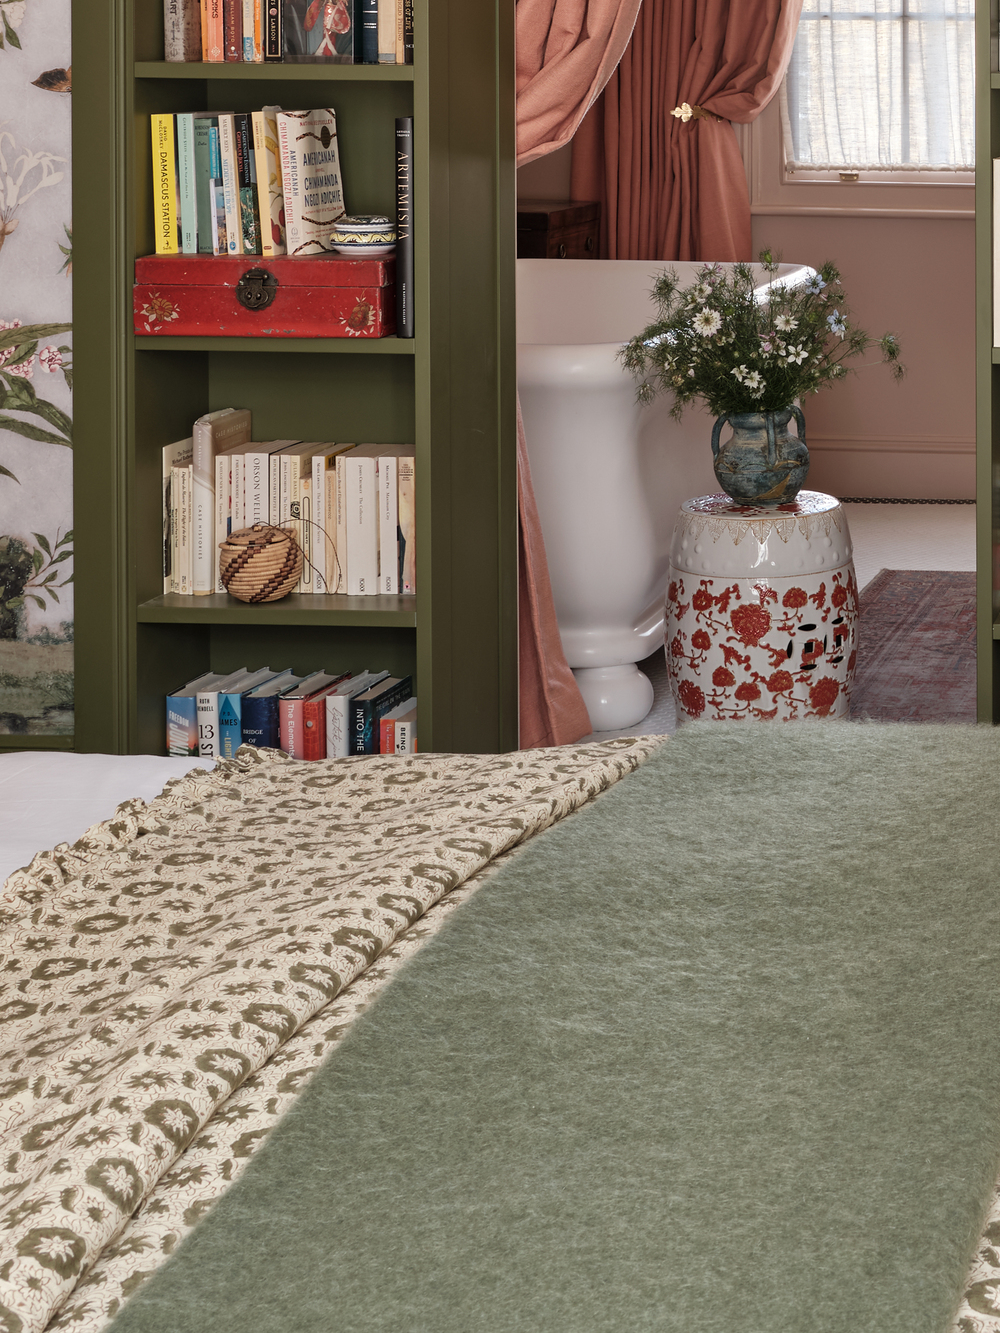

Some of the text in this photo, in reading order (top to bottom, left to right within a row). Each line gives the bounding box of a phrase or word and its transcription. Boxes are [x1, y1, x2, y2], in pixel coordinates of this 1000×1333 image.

[279, 122, 294, 225] CHIMAMANDA NGOZI ADICHIE
[289, 150, 299, 197] AMERICANAH
[303, 150, 336, 166] AMERICANAH
[160, 151, 171, 238] DAMASCUS STATION
[304, 173, 339, 191] CHIMAMANDA
[304, 189, 342, 207] NGOZI ADICHIE
[398, 151, 409, 240] ARTEMISIA
[253, 457, 261, 490] ORSON
[169, 710, 189, 727] FREEDOM
[198, 724, 214, 740] 13
[356, 709, 365, 751] INTO THE
